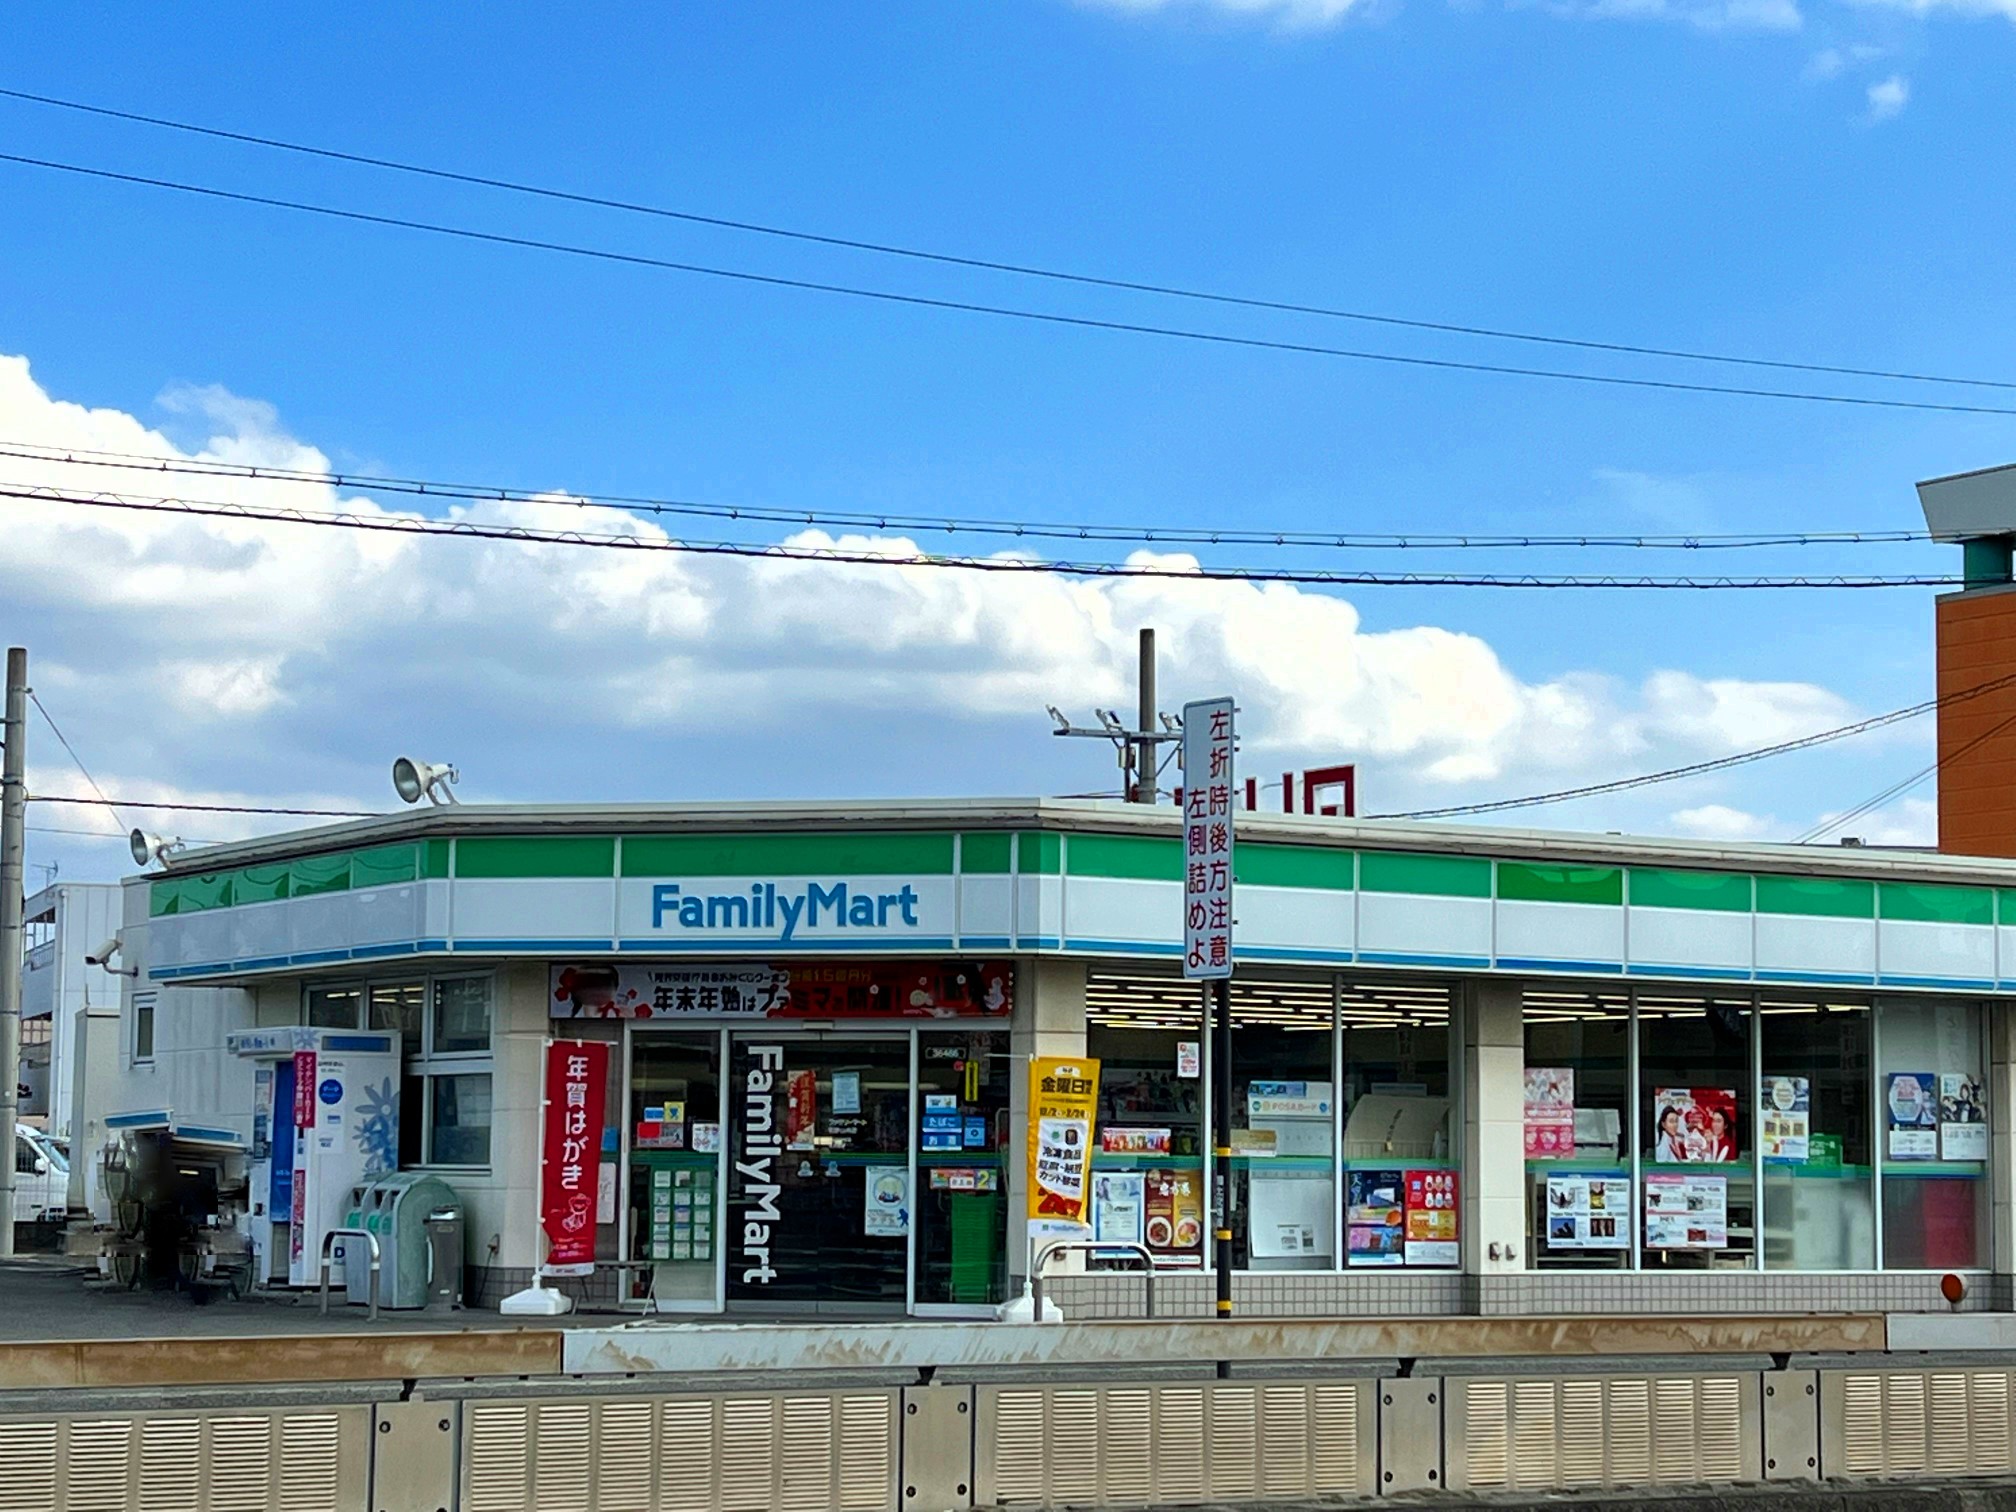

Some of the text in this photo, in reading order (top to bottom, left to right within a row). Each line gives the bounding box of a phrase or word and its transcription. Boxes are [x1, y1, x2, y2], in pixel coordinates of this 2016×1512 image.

[653, 883, 918, 940] FamilyMart
[1187, 788, 1208, 969] 左側詰めよ
[1208, 710, 1230, 967] 左折時後方注意
[562, 1055, 589, 1190] 年賀はがき
[736, 1046, 783, 1284] FamilyMart
